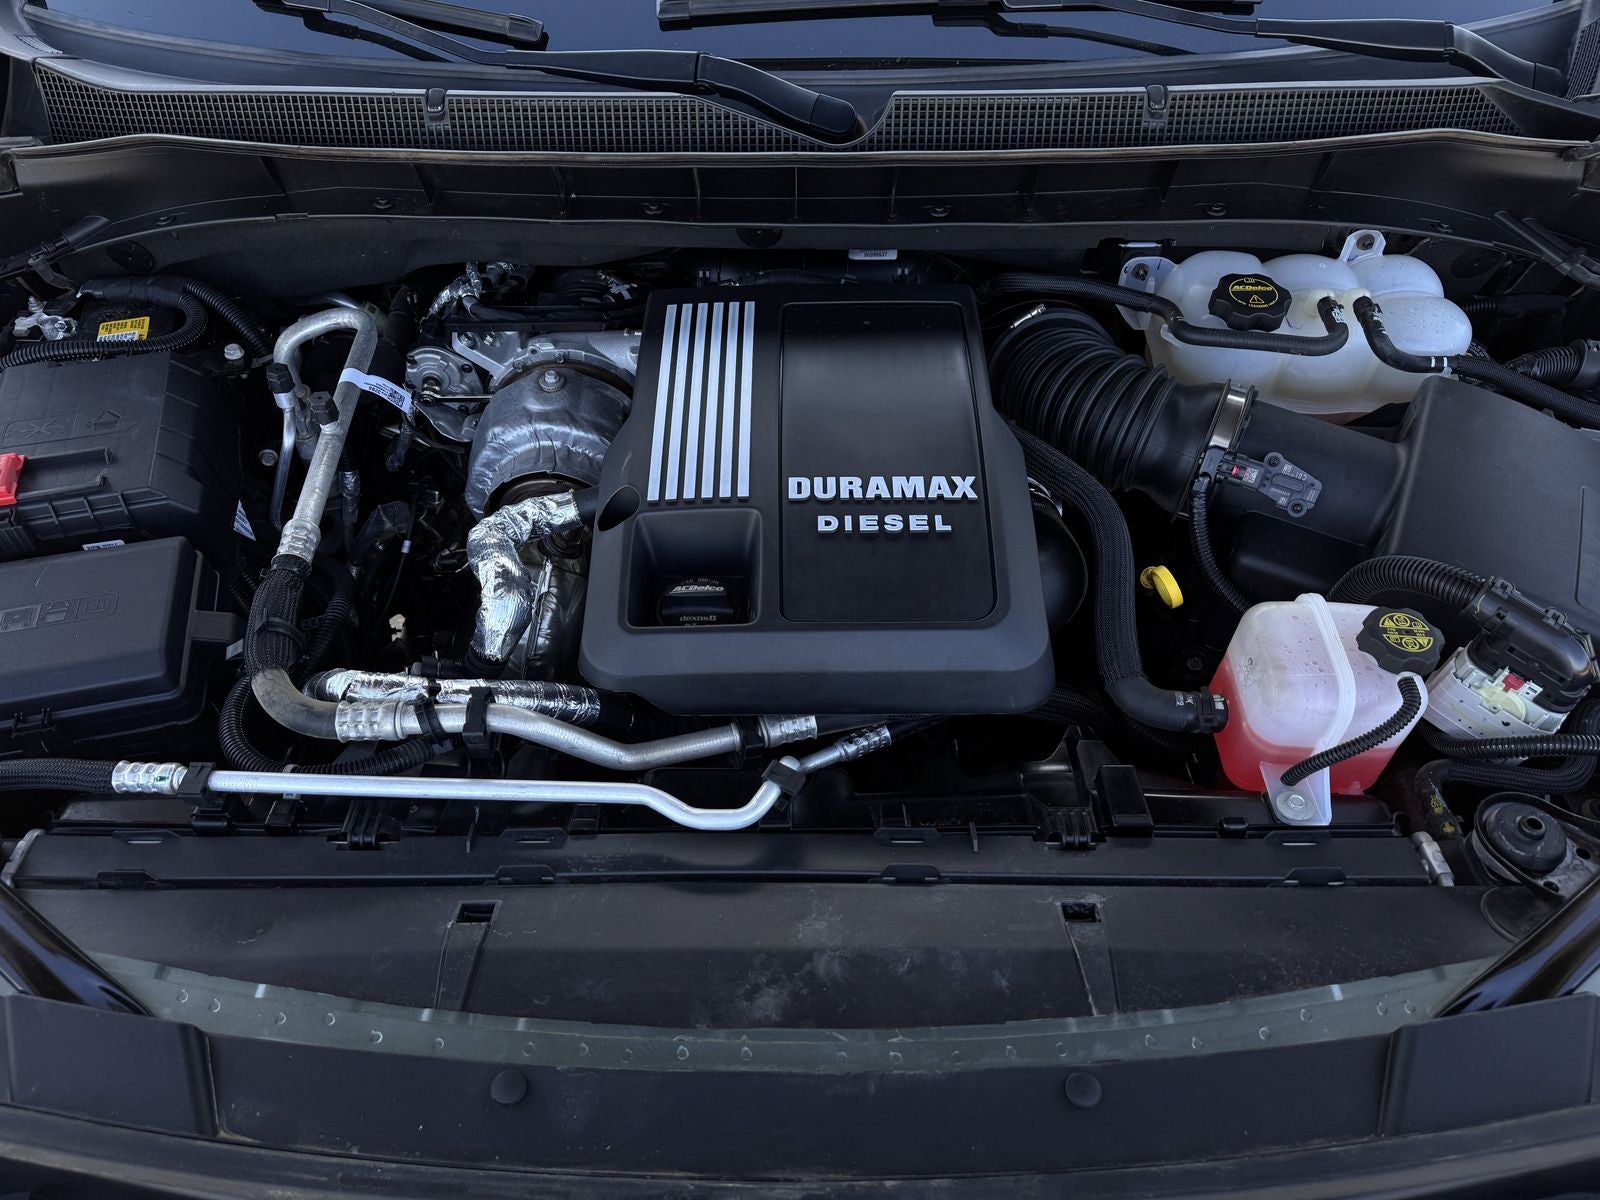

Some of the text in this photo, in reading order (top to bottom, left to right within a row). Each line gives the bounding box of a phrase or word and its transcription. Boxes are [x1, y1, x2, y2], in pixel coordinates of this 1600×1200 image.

[788, 476, 978, 501] DURAMAX
[817, 514, 952, 533] DIESEL
[672, 584, 725, 592] ACDelco
